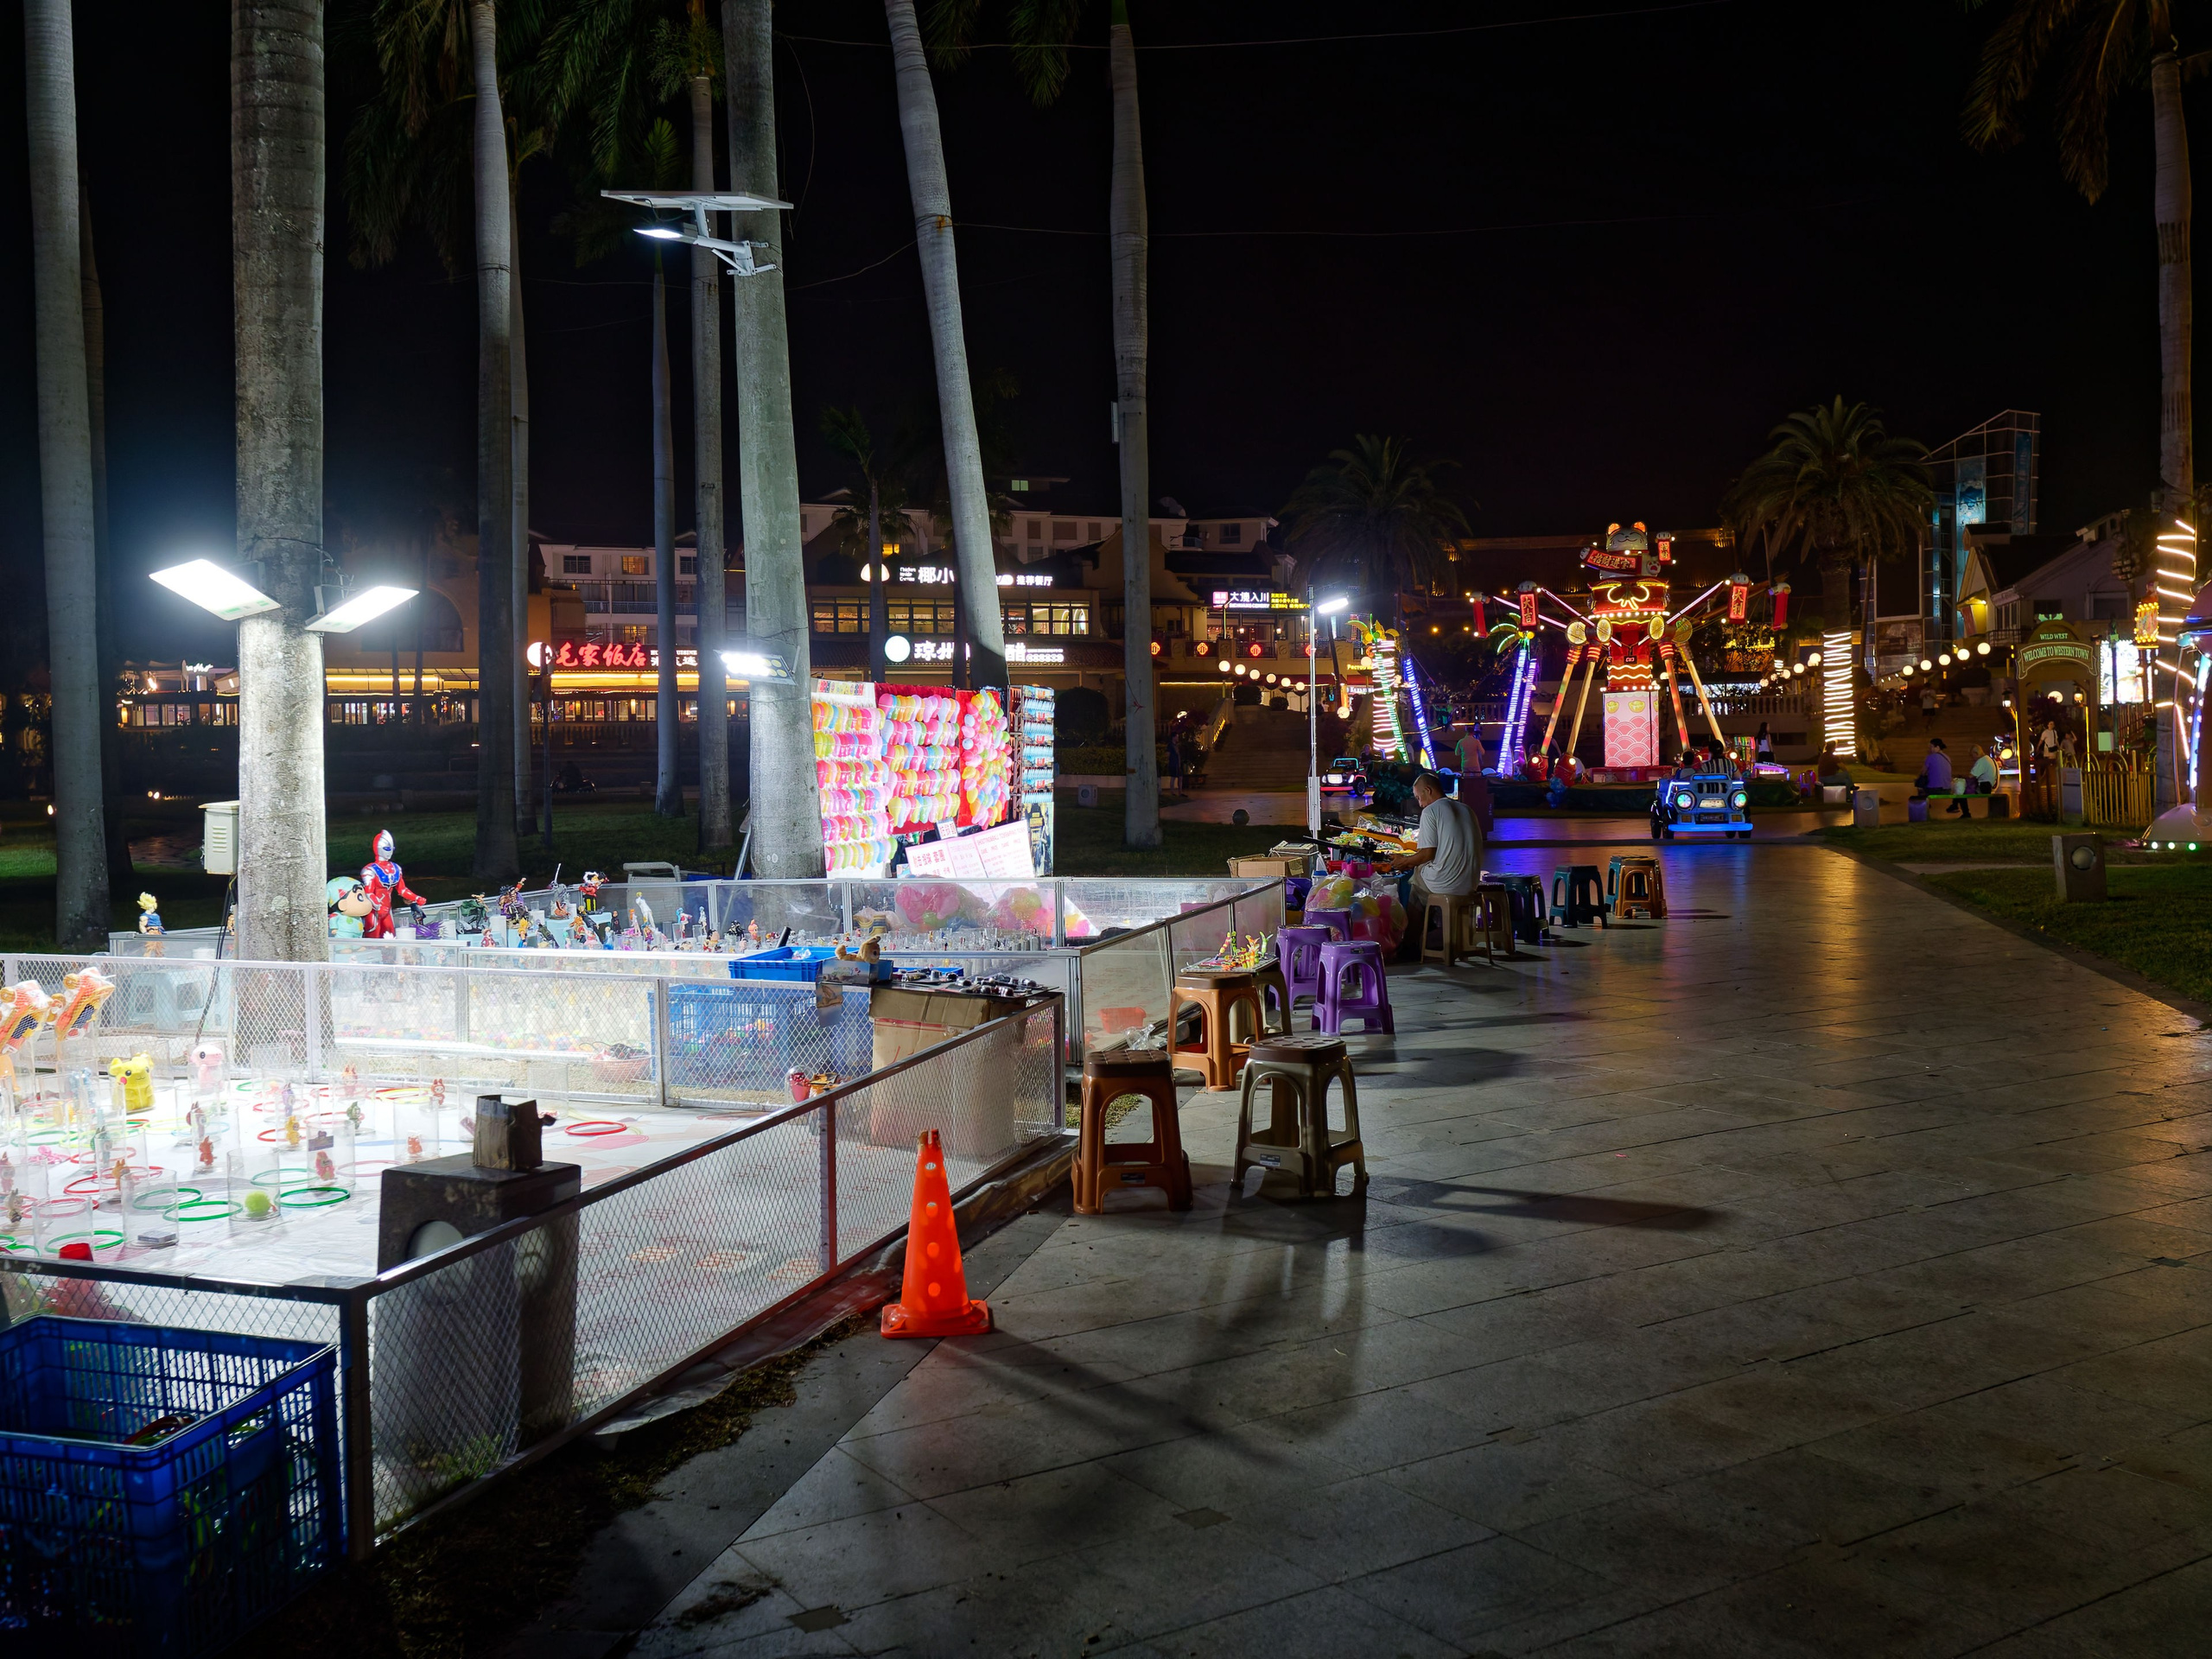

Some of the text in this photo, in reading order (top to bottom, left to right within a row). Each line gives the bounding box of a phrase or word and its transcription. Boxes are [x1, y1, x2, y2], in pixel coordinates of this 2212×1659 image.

[1592, 553, 1630, 569] 招财进宝
[1016, 575, 1053, 587] 推荐餐厅
[1522, 595, 1533, 623] 大吉
[1732, 588, 1744, 616] 大利
[556, 642, 647, 667] 毛家饭店
[2023, 645, 2089, 662] WELCOME TO WESTERN TOWN
